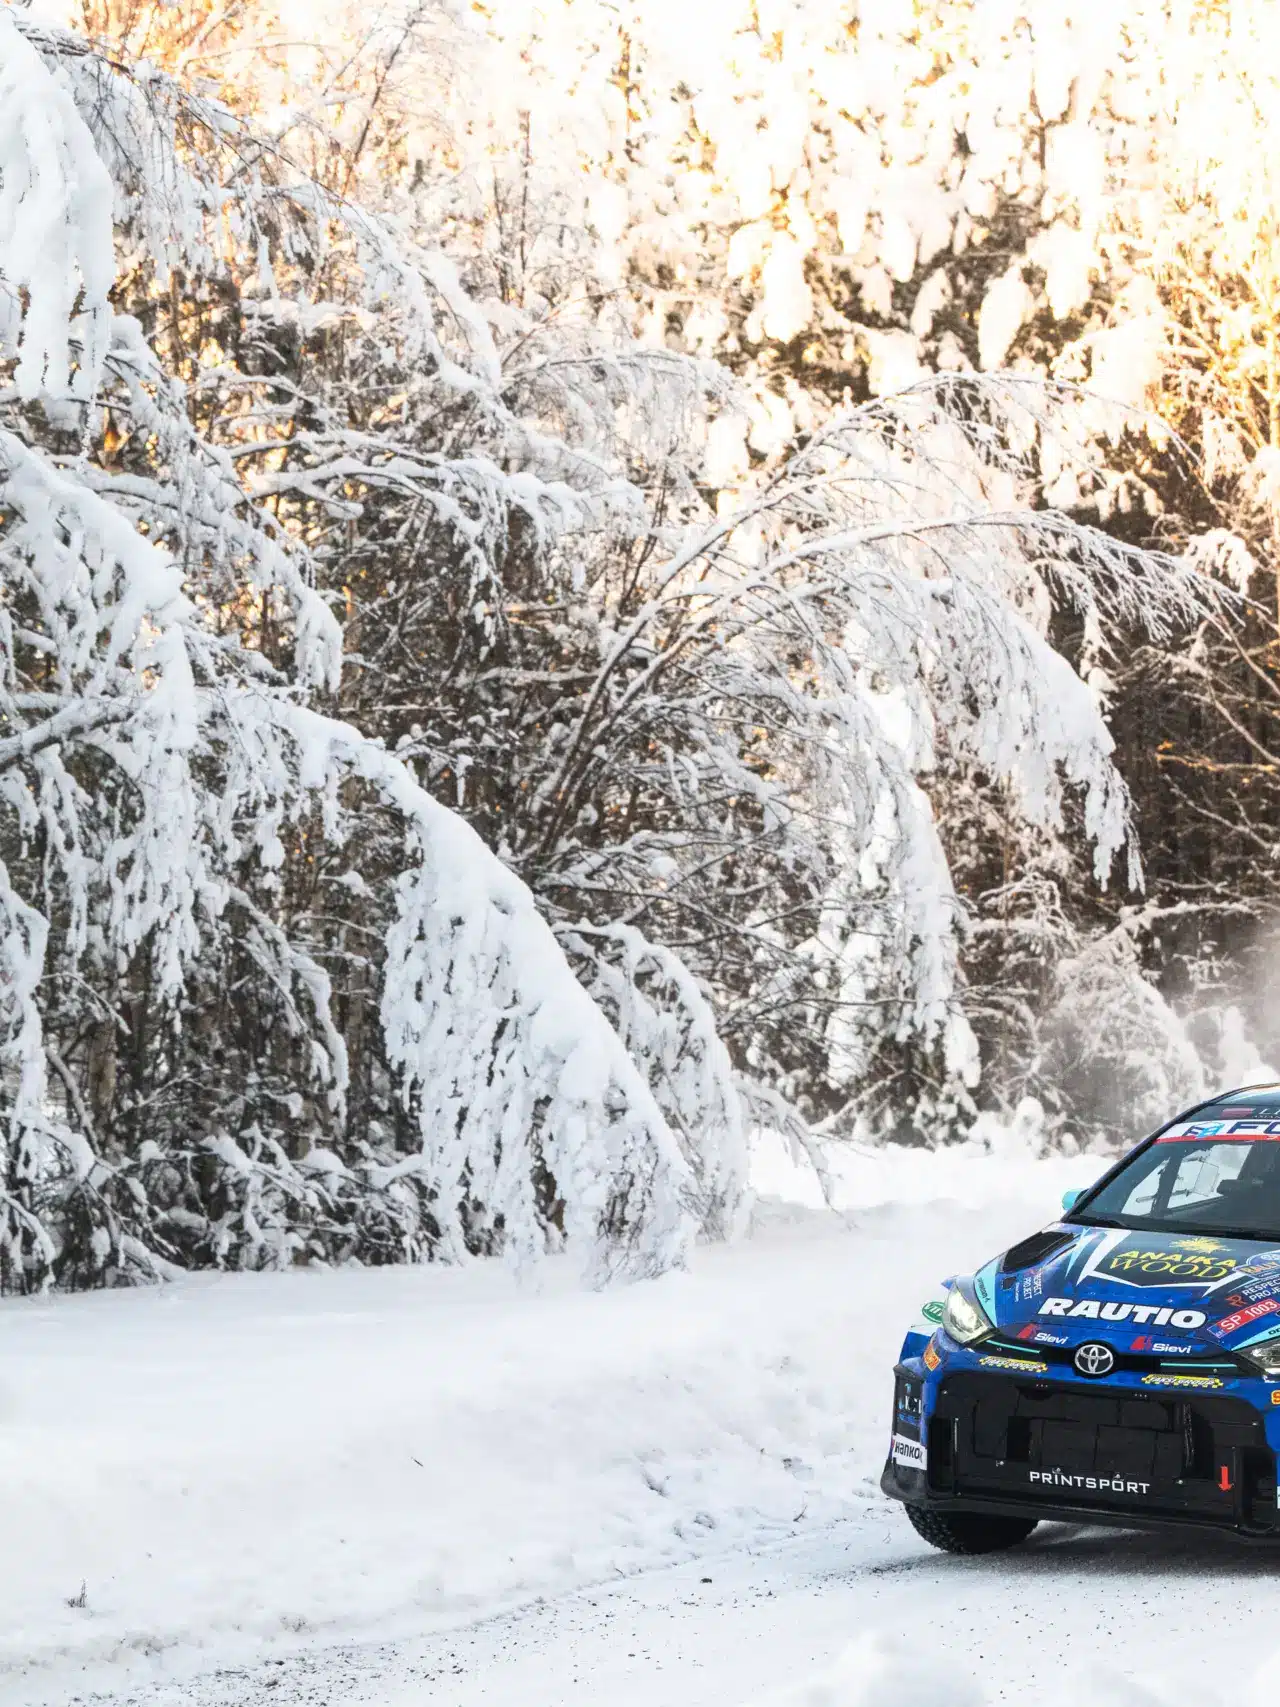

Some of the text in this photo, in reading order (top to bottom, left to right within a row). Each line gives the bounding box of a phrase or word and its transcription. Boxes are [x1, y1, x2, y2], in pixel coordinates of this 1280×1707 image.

[1109, 1257, 1228, 1278] WOOD
[1118, 1250, 1237, 1267] ANAIKA
[1037, 1297, 1208, 1329] RAUTIO
[1220, 1300, 1278, 1331] SP 1003
[1034, 1331, 1068, 1345] Sievi
[1151, 1342, 1192, 1354] Sievi
[1030, 1471, 1150, 1495] PRINTSPORT
